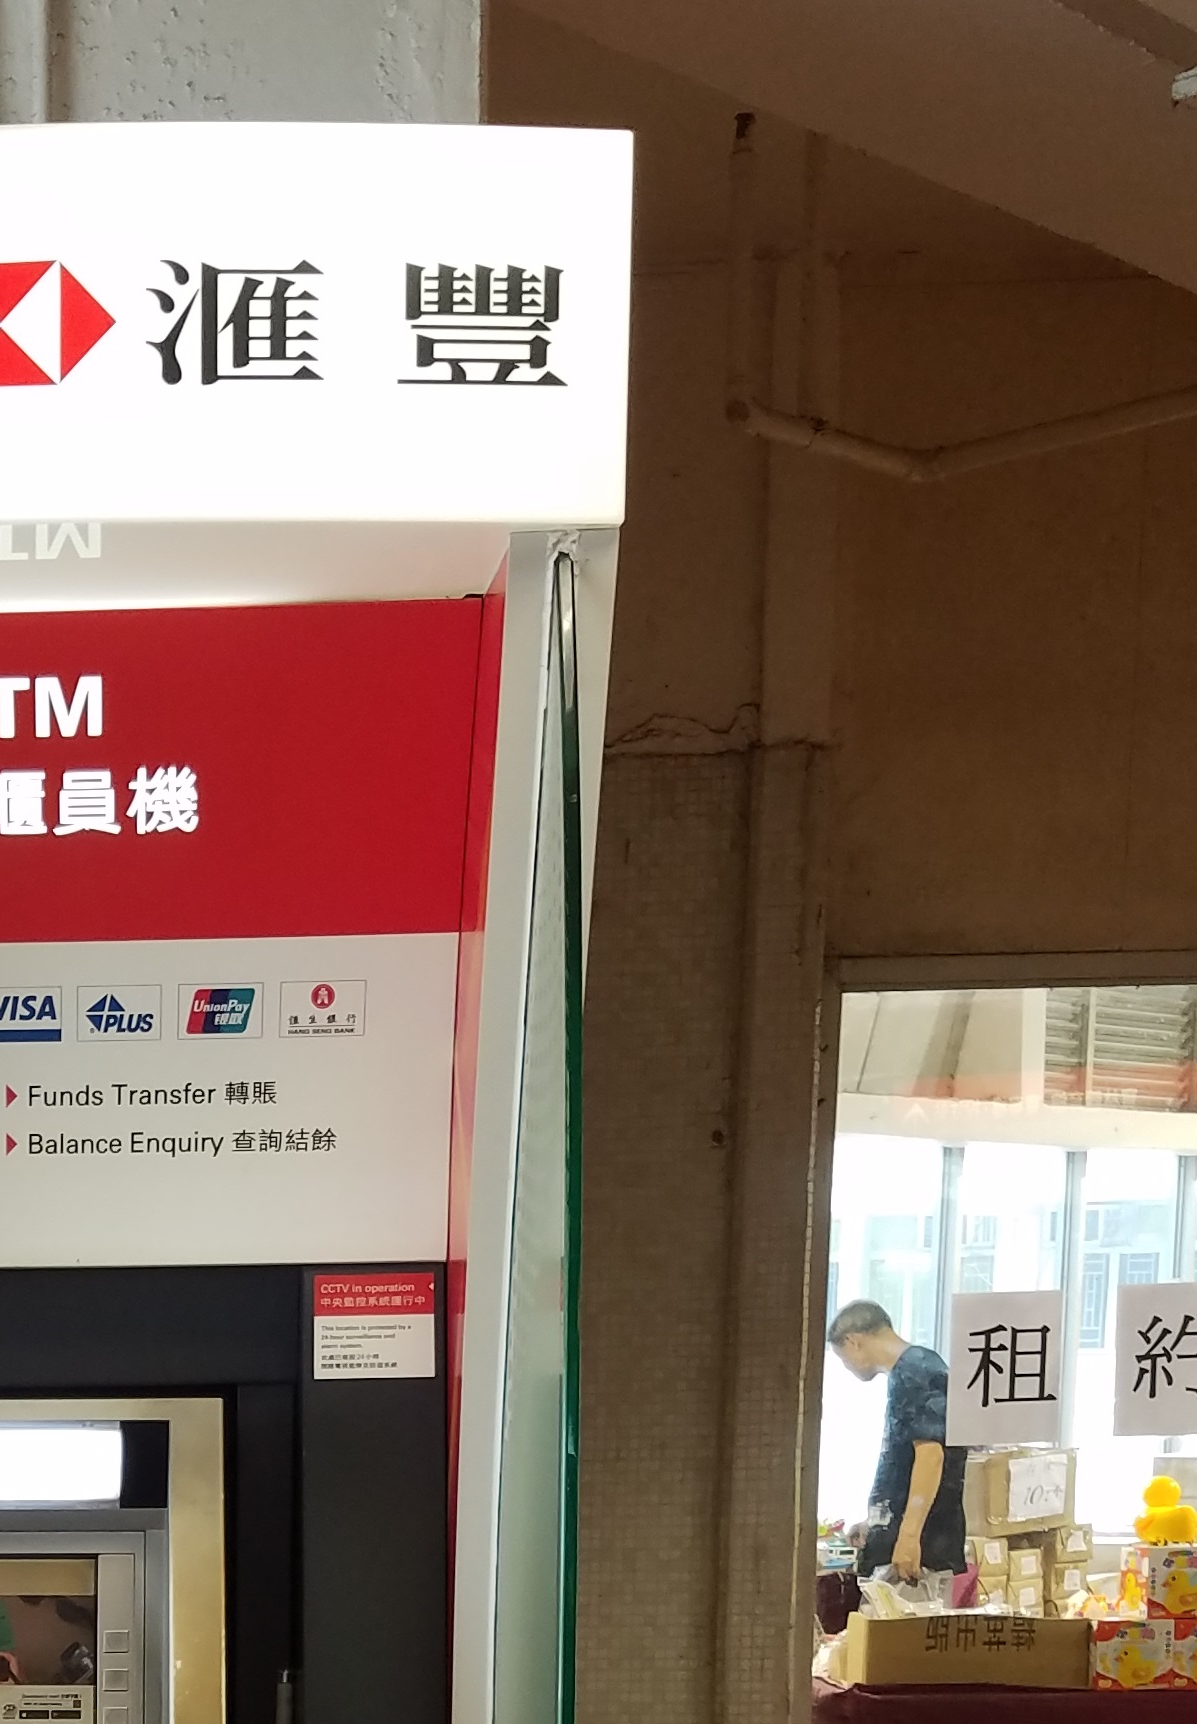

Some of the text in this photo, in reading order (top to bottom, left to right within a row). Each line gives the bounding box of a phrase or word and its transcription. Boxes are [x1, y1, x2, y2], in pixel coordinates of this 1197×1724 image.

[193, 999, 250, 1014] UnionPay
[103, 1013, 154, 1033] PLUS
[28, 1084, 104, 1107] Funds
[111, 1082, 216, 1106] Transfer
[28, 1128, 337, 1158] Balance Enquiry 查詢結餘
[320, 1283, 415, 1294] CCTV in operation
[967, 1324, 1057, 1407] 租
